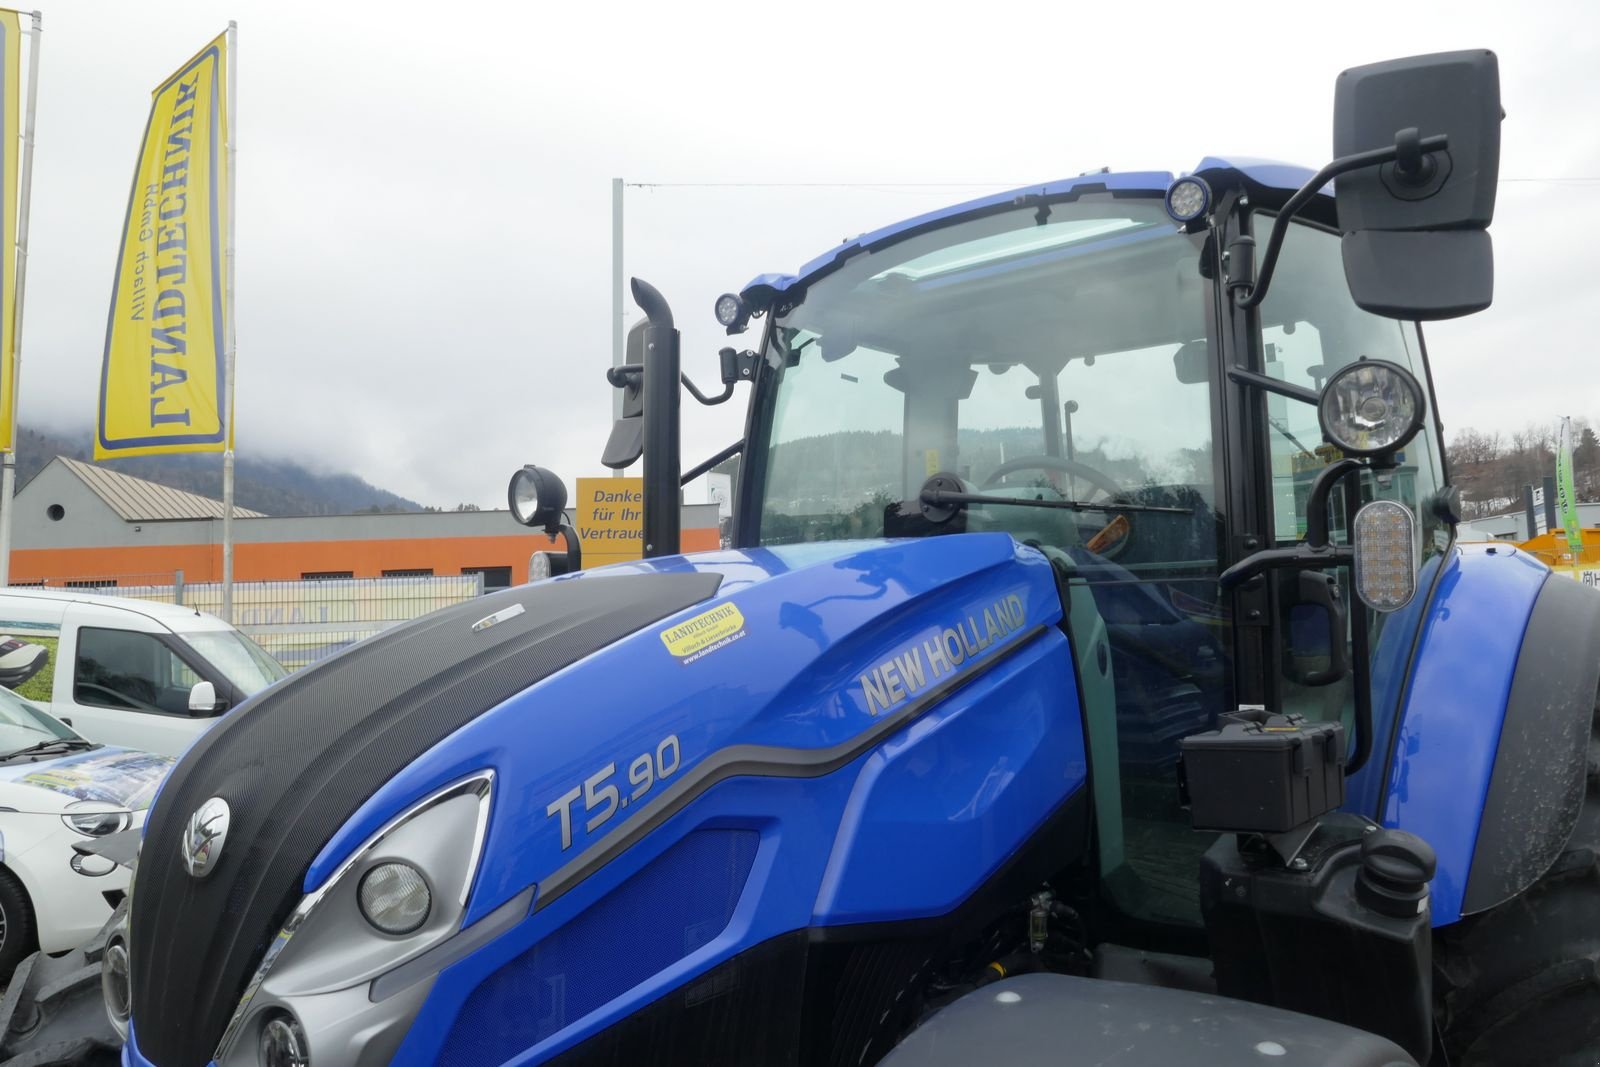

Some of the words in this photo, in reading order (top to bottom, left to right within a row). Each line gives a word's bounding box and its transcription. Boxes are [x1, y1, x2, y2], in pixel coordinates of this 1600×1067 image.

[593, 490, 642, 503] Danke
[592, 508, 615, 521] für
[621, 508, 642, 521] Ihr
[580, 527, 644, 540] Vertraue
[665, 606, 735, 644] LANDTECHNIK
[683, 630, 746, 665] www.landtechnik.co.at
[859, 653, 926, 717] NEW
[928, 594, 1026, 679] HOLLAND
[546, 733, 681, 852] T5.90
